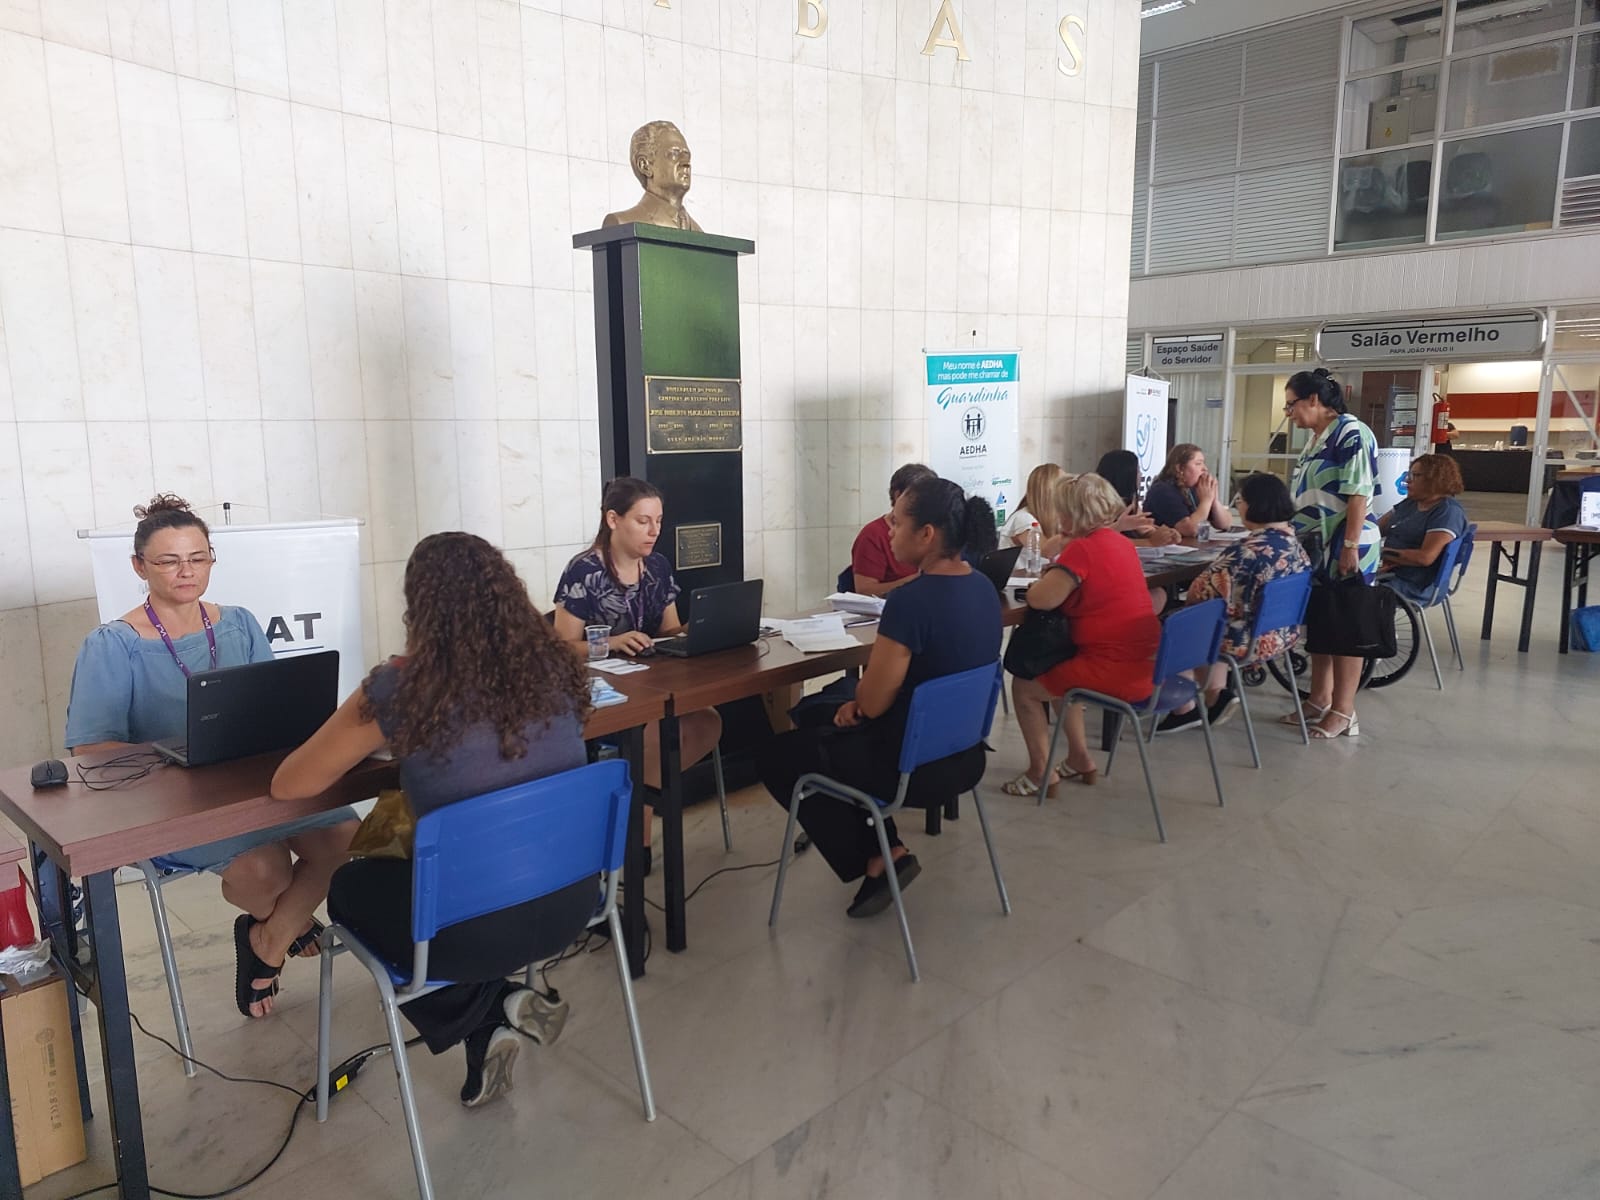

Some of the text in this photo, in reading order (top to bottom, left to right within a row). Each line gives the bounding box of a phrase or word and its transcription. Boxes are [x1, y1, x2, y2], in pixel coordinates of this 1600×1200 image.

[1351, 327, 1500, 348] Salão Vermelho
[1156, 343, 1219, 354] Espaço Saúde
[943, 361, 957, 370] Meu
[957, 361, 976, 369] nome
[981, 359, 1004, 369] AEDHA
[1161, 355, 1212, 365] do Servidor
[951, 371, 968, 382] pode
[968, 371, 980, 379] me
[1001, 369, 1009, 378] de
[937, 386, 1008, 410] Guardinha
[960, 444, 987, 455] AEDHA
[265, 612, 322, 644] AT
